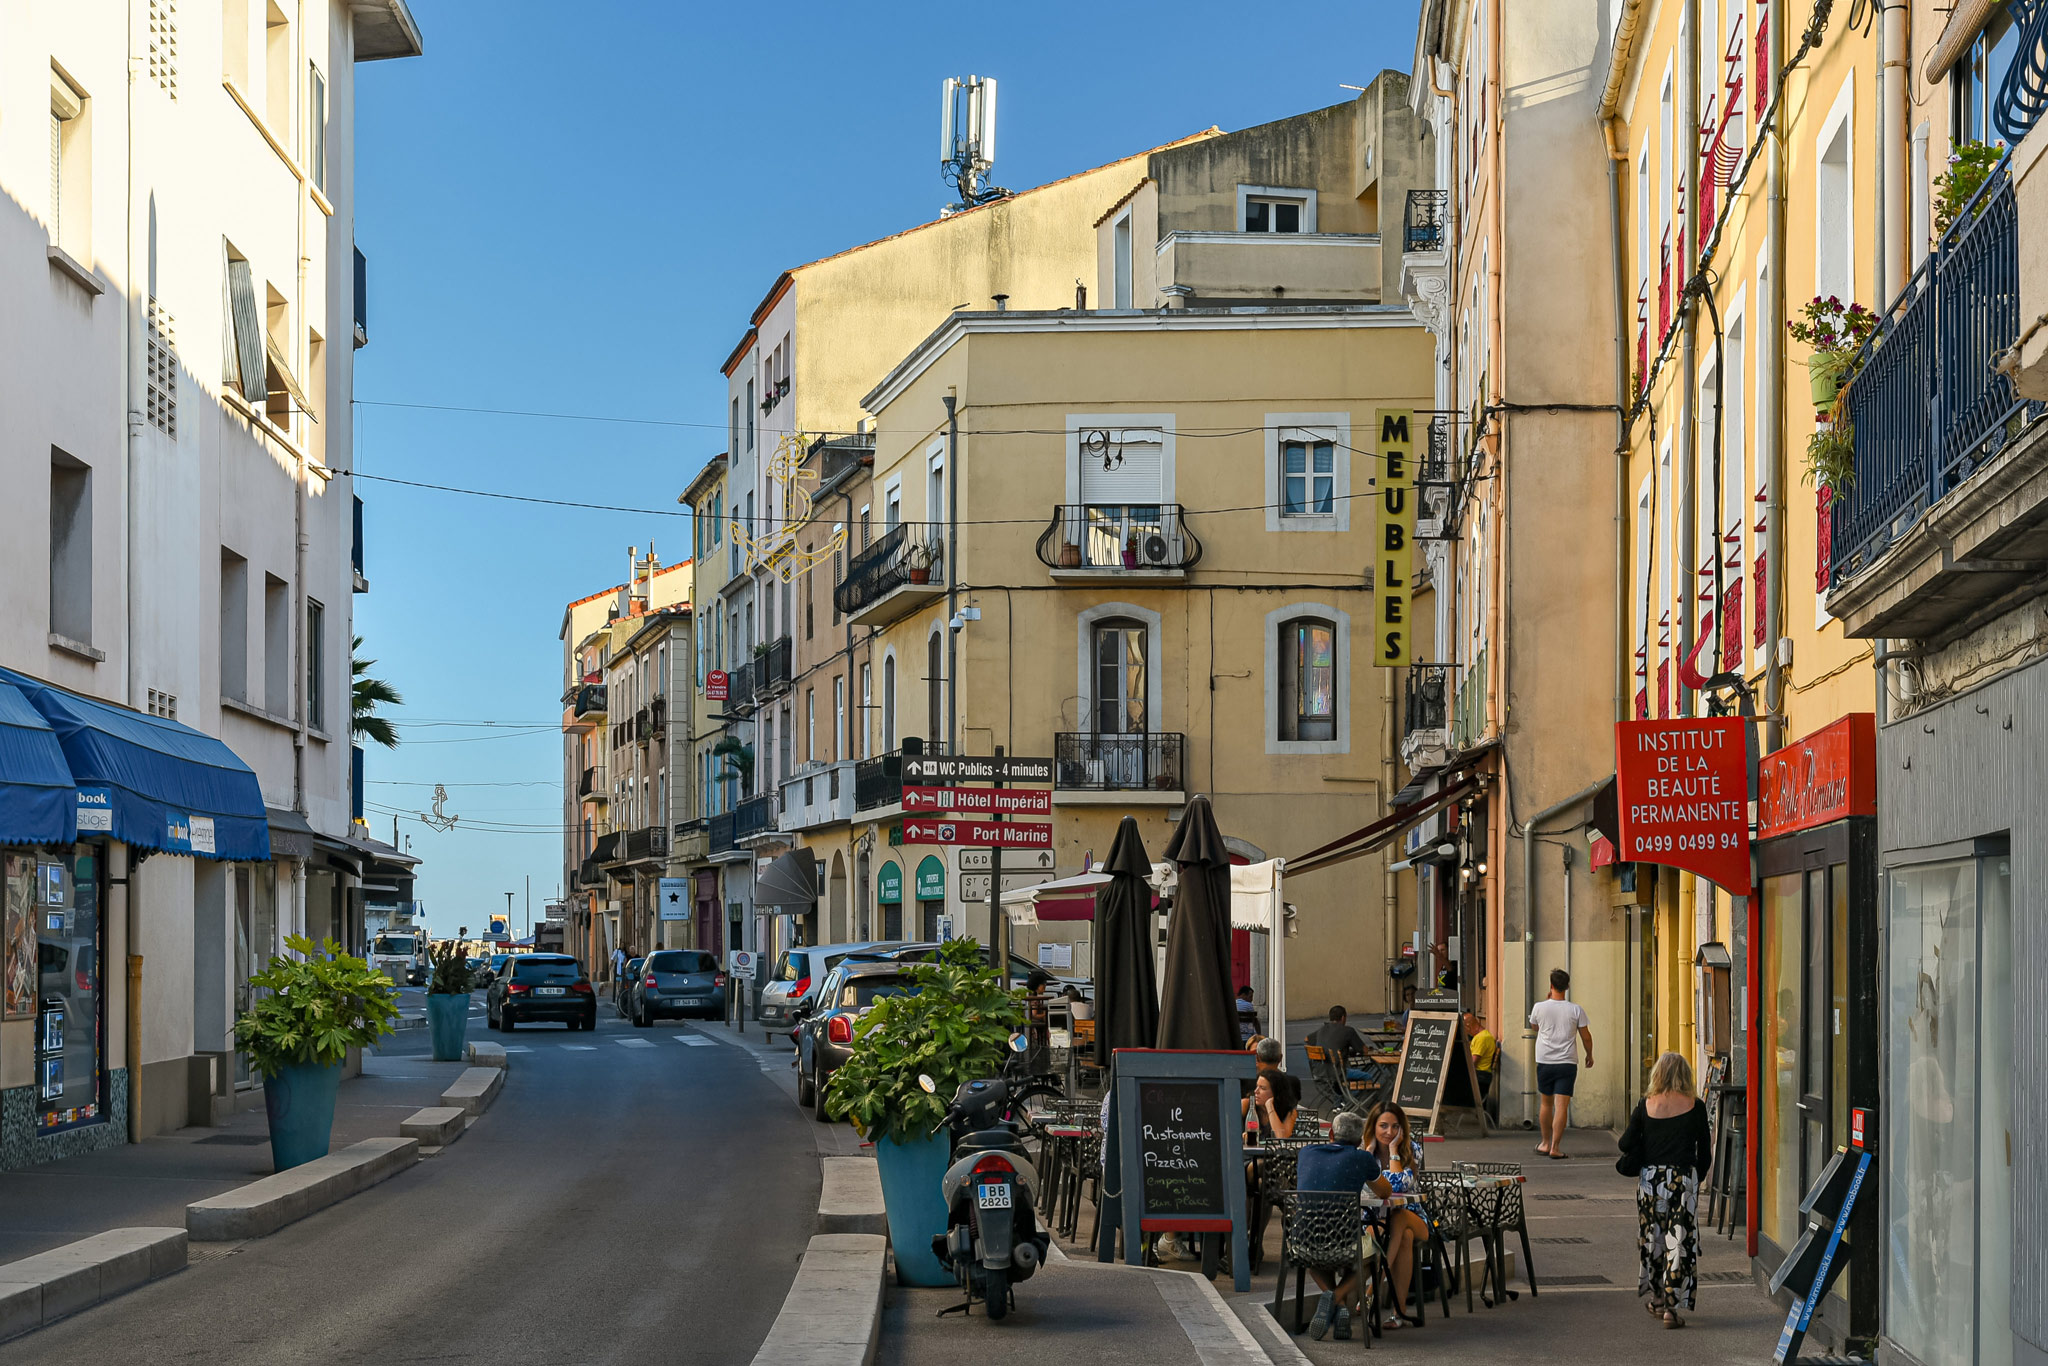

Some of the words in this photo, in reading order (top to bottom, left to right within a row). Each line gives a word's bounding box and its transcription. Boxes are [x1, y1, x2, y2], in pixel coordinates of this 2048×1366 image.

[1382, 415, 1409, 660] MEUBLES
[1638, 729, 1726, 752] INSTITUT
[939, 762, 956, 776] WC
[958, 762, 993, 776] Publics
[1002, 764, 1009, 776] 4
[1011, 763, 1049, 777] minutes
[1657, 756, 1679, 773] DE
[1686, 756, 1708, 772] LA
[1647, 770, 1720, 798] BEAUTÉ
[1800, 747, 1847, 820] Romaine
[957, 793, 991, 807] Hôtel
[995, 795, 1048, 810] Impérial
[1631, 801, 1740, 824] PERMANENTE
[973, 826, 999, 841] Port
[1003, 828, 1048, 842] Marine
[1635, 835, 1673, 853] 0499
[1679, 833, 1716, 851] 0499
[1721, 832, 1739, 849] 94
[982, 877, 1010, 887] Cir
[965, 889, 977, 898] La
[989, 1185, 1006, 1197] BB
[1173, 1186, 1188, 1194] et
[981, 1197, 1009, 1208] 282G
[1835, 1166, 1866, 1235] www.imobook.fr
[1802, 1252, 1832, 1322] www.imobook.fr
